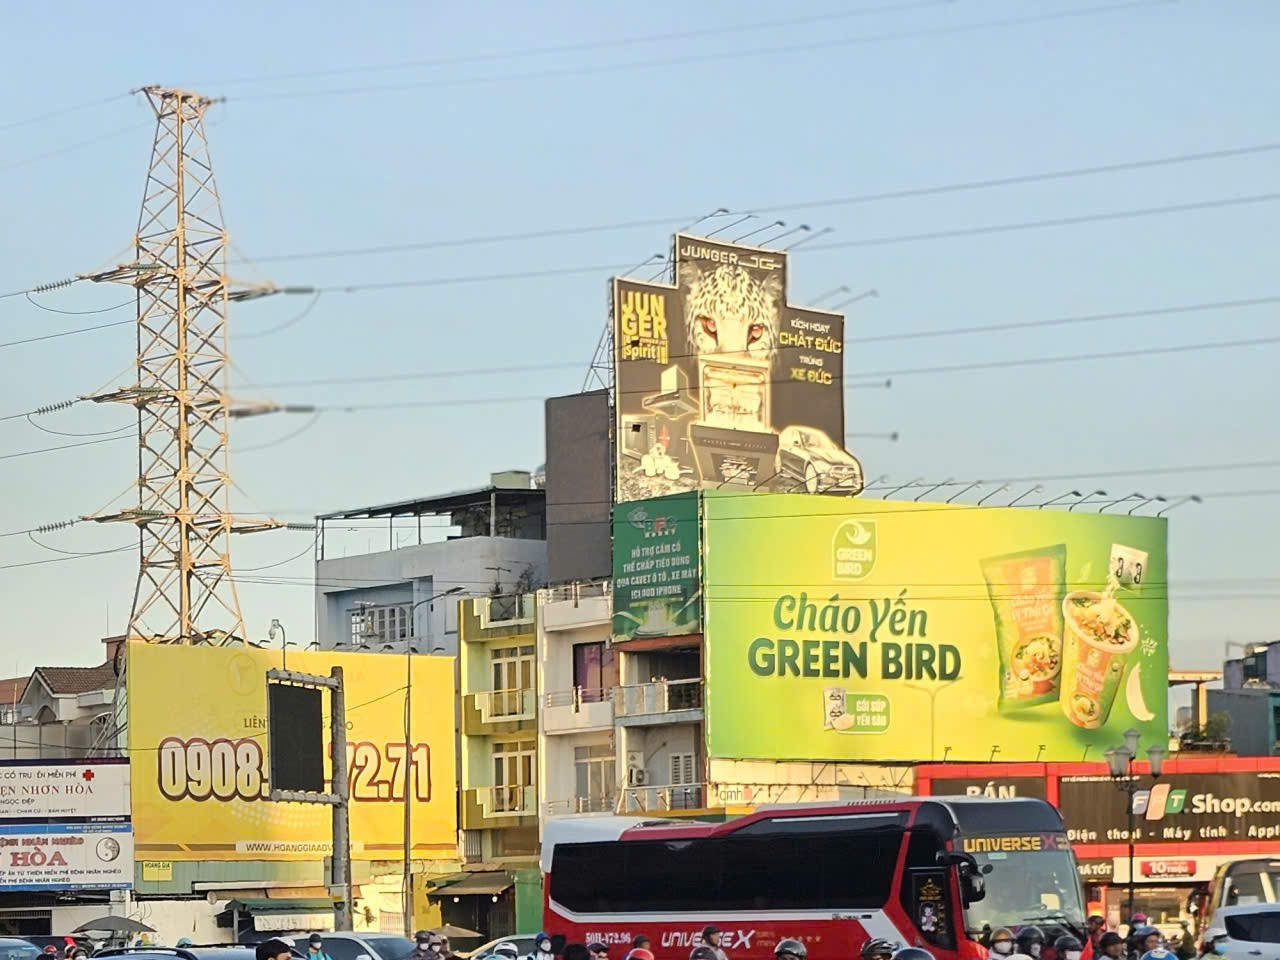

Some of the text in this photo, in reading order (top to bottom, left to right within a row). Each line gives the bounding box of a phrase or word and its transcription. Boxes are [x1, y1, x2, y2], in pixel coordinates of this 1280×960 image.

[681, 245, 738, 265] JUNGER
[836, 548, 872, 562] GREEN
[836, 562, 862, 575] BIRD
[773, 588, 928, 642] Cháo Yến
[748, 638, 962, 681] GREEN BIRD
[1067, 830, 1097, 843] Điện
[1163, 826, 1191, 841] Máy
[1199, 826, 1227, 838] tính
[10, 846, 67, 867] HÒA
[1150, 861, 1167, 873] 10
